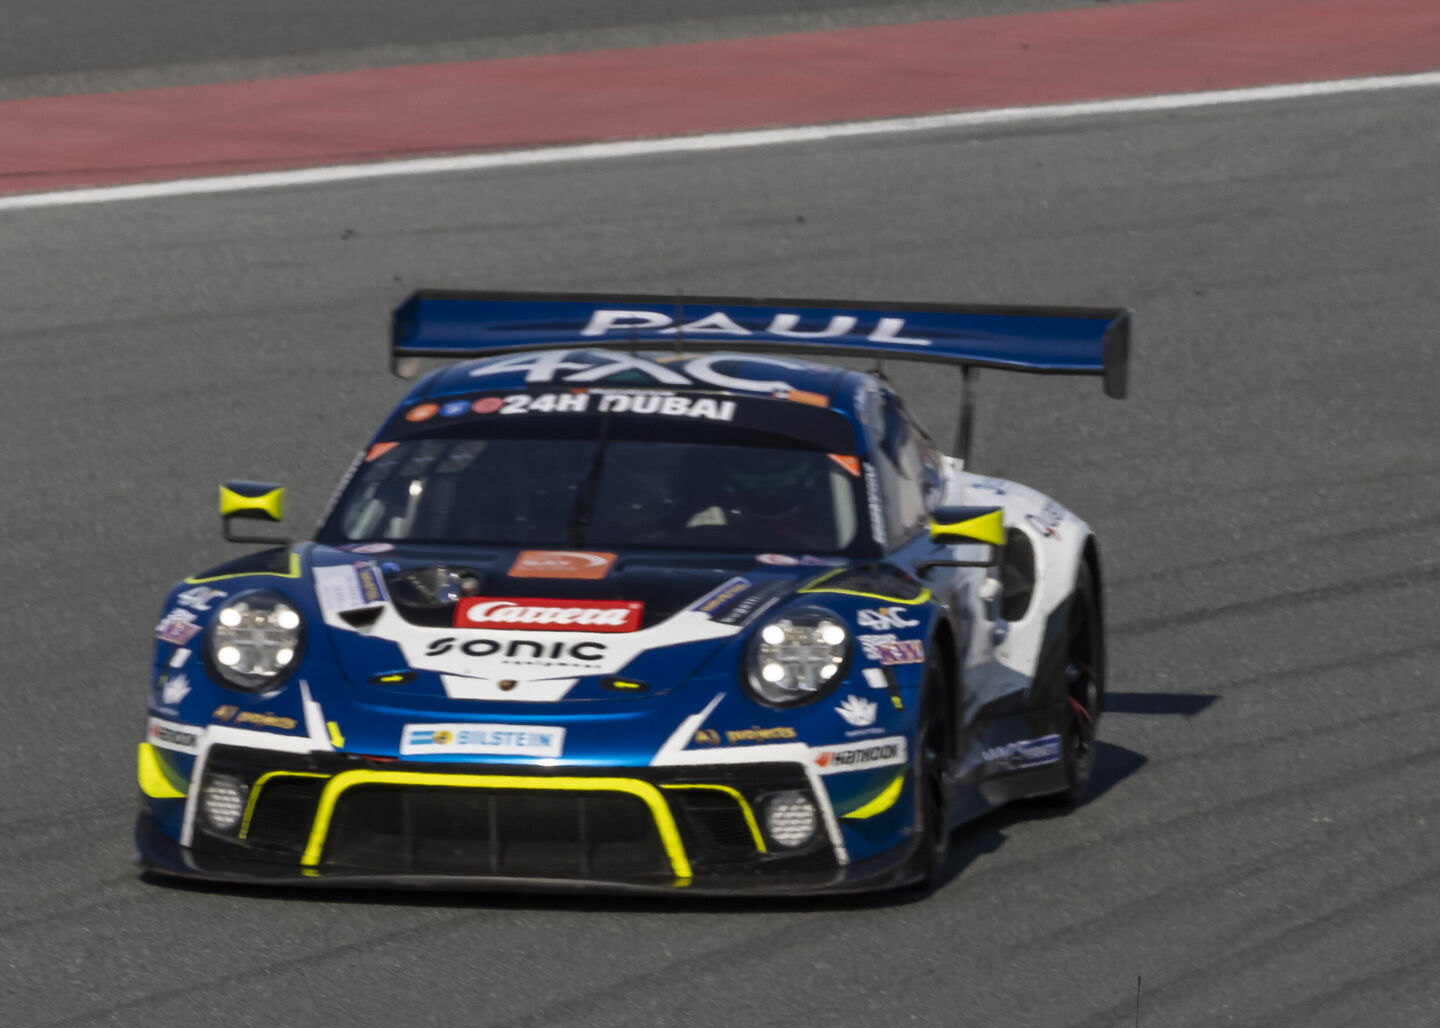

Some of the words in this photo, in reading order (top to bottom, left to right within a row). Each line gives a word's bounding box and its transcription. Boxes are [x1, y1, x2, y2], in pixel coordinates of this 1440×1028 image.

[580, 309, 932, 346] PAUL
[499, 393, 590, 414] 24H
[597, 394, 737, 421] DUBAI
[466, 600, 632, 626] Carrera
[457, 730, 554, 747] BILSTEIN
